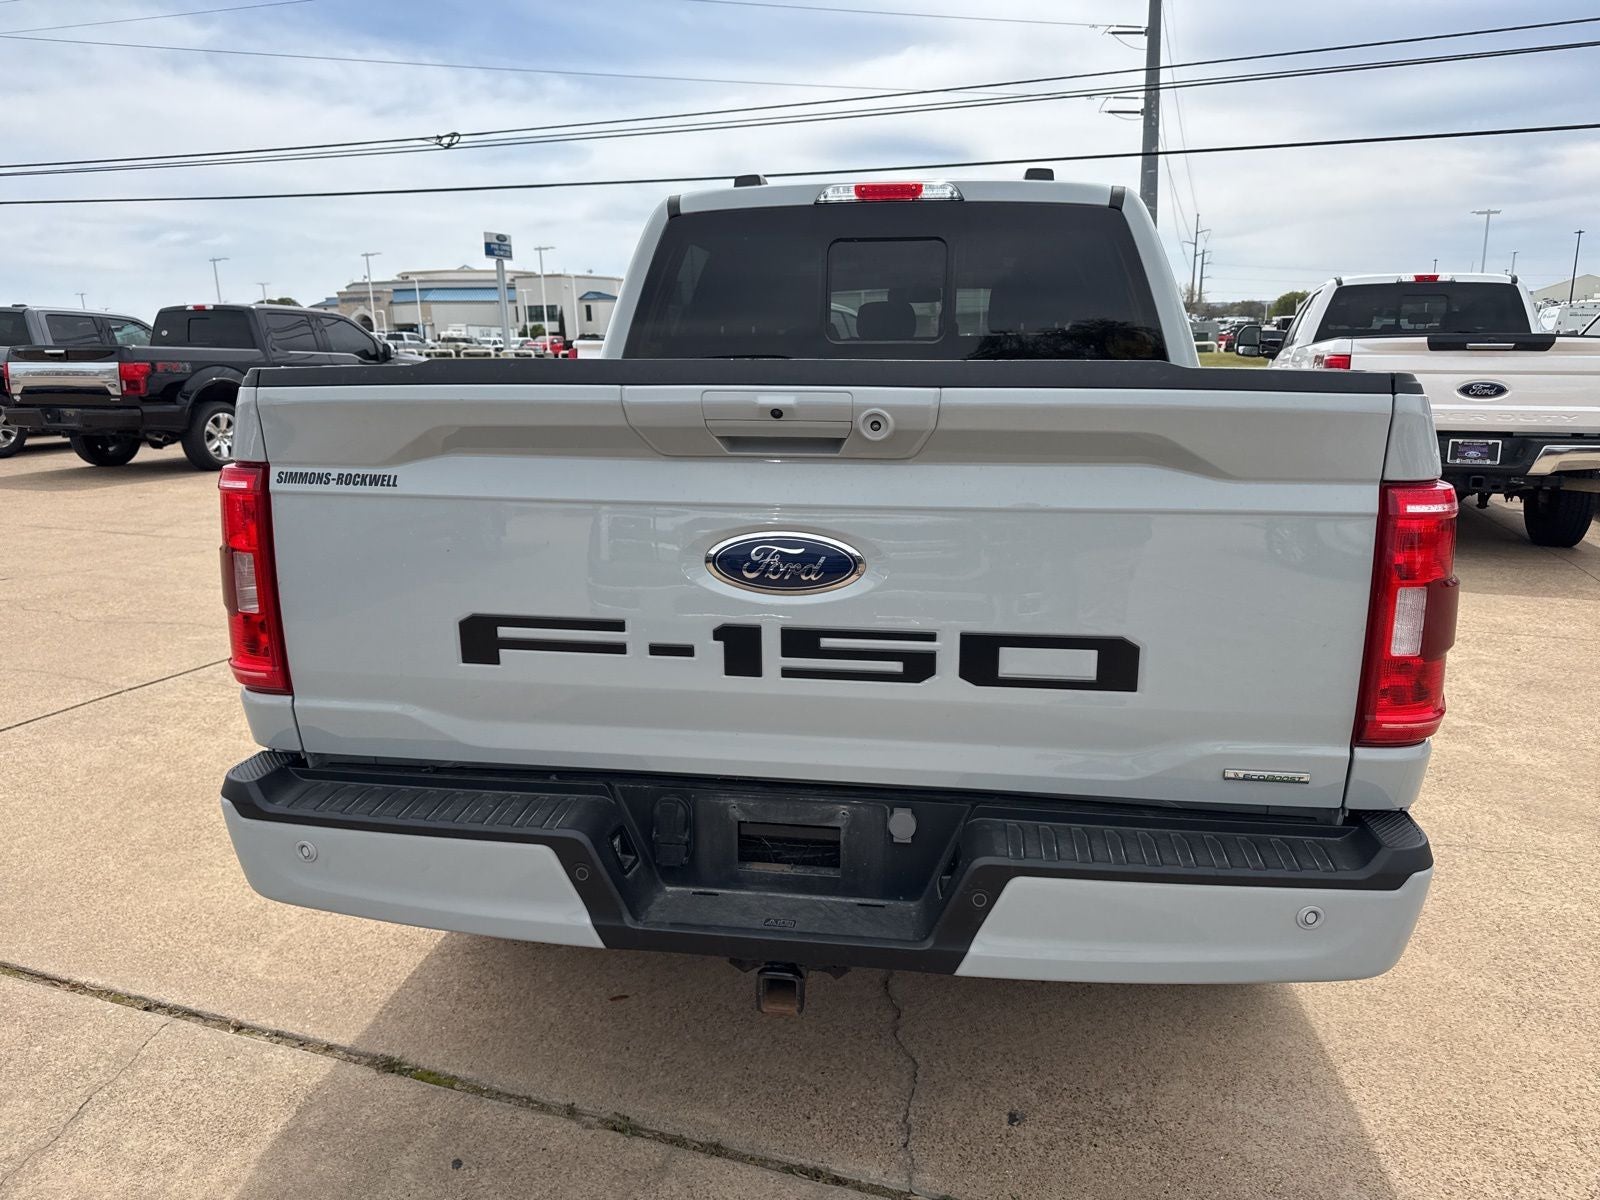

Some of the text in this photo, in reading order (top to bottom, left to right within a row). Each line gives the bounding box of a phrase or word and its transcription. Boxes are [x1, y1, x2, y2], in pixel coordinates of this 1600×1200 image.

[1468, 383, 1497, 396] Ford
[1431, 412, 1579, 423] PER DUTY
[276, 471, 398, 487] SIMMONS-ROCKWELL
[742, 545, 826, 581] Ford
[458, 613, 1141, 693] F-150
